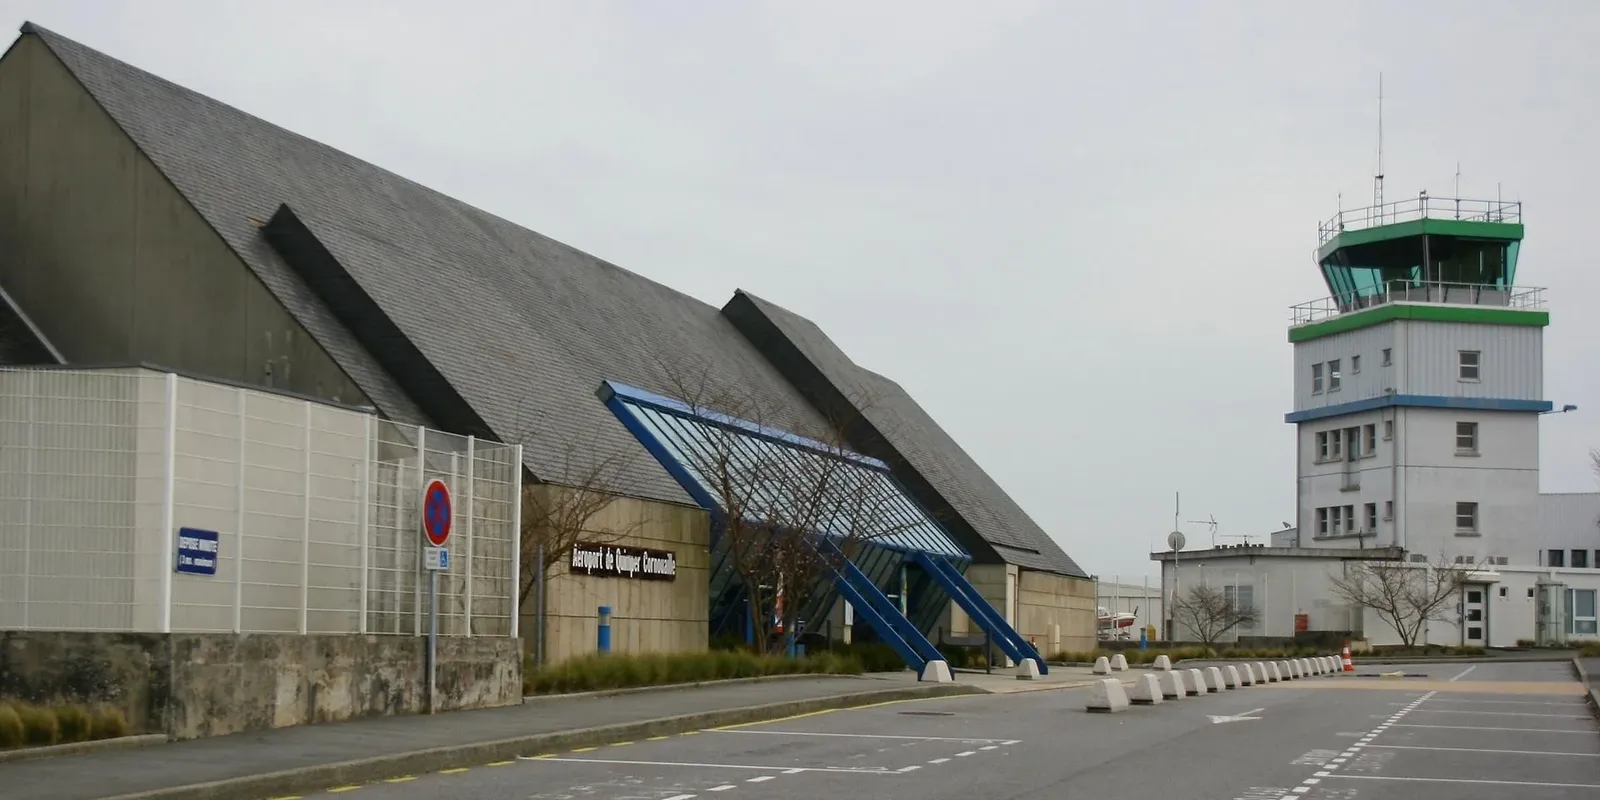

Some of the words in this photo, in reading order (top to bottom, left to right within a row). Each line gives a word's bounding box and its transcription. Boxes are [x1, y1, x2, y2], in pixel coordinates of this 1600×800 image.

[605, 547, 614, 570] de
[616, 547, 641, 578] Quimper
[643, 551, 676, 575] Cornouaille
